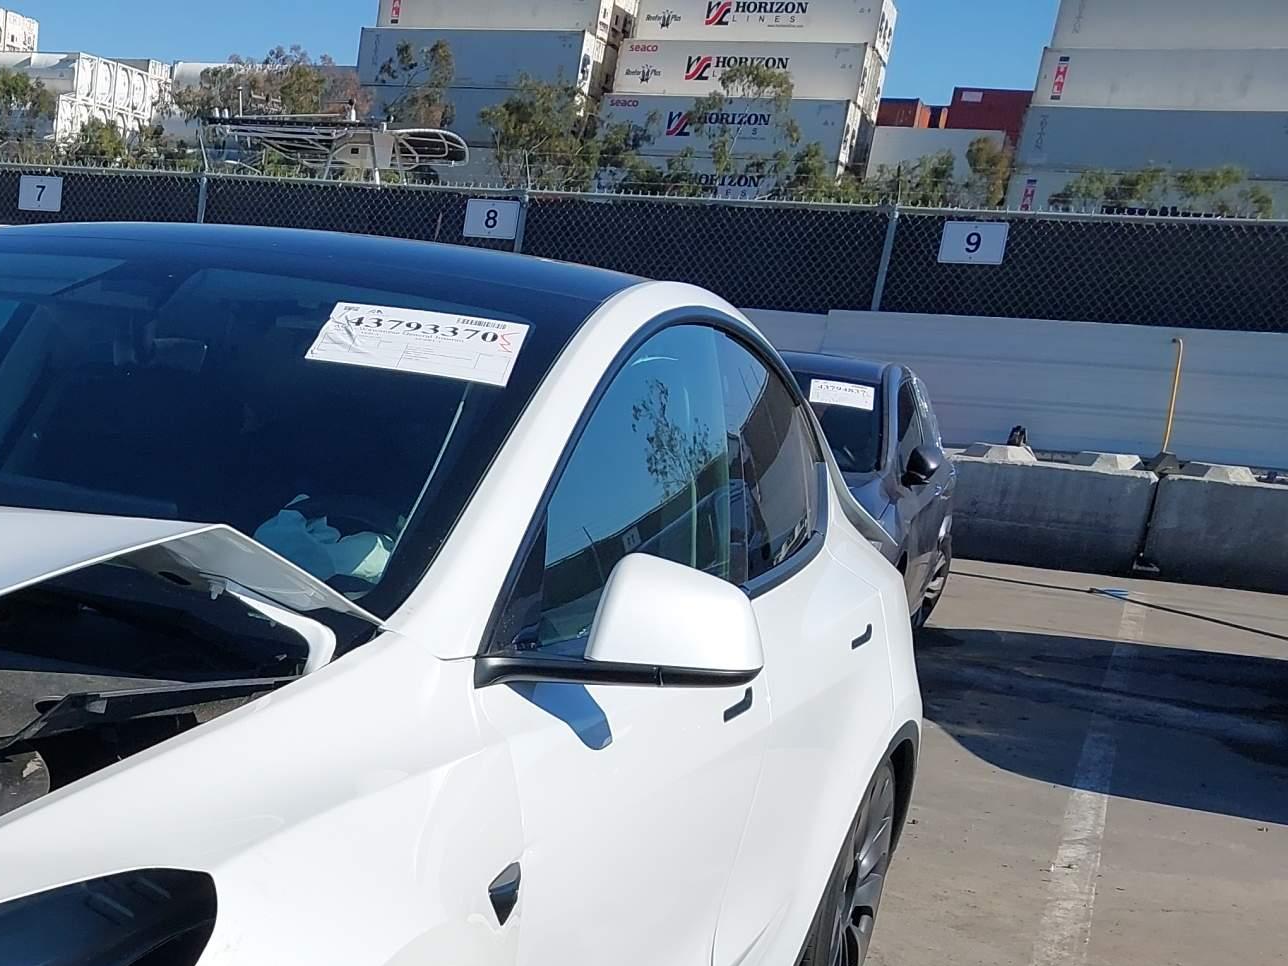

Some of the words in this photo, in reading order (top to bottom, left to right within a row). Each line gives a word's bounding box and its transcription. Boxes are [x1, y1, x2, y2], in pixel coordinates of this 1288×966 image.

[734, 1, 809, 15] HORIZON
[731, 15, 797, 23] LINES
[629, 43, 659, 53] seaco
[610, 98, 639, 108] seaco
[694, 173, 763, 188] ORIZON
[35, 184, 47, 202] 7
[484, 209, 499, 229] 8
[965, 232, 982, 253] 9
[351, 315, 500, 343] 43793370
